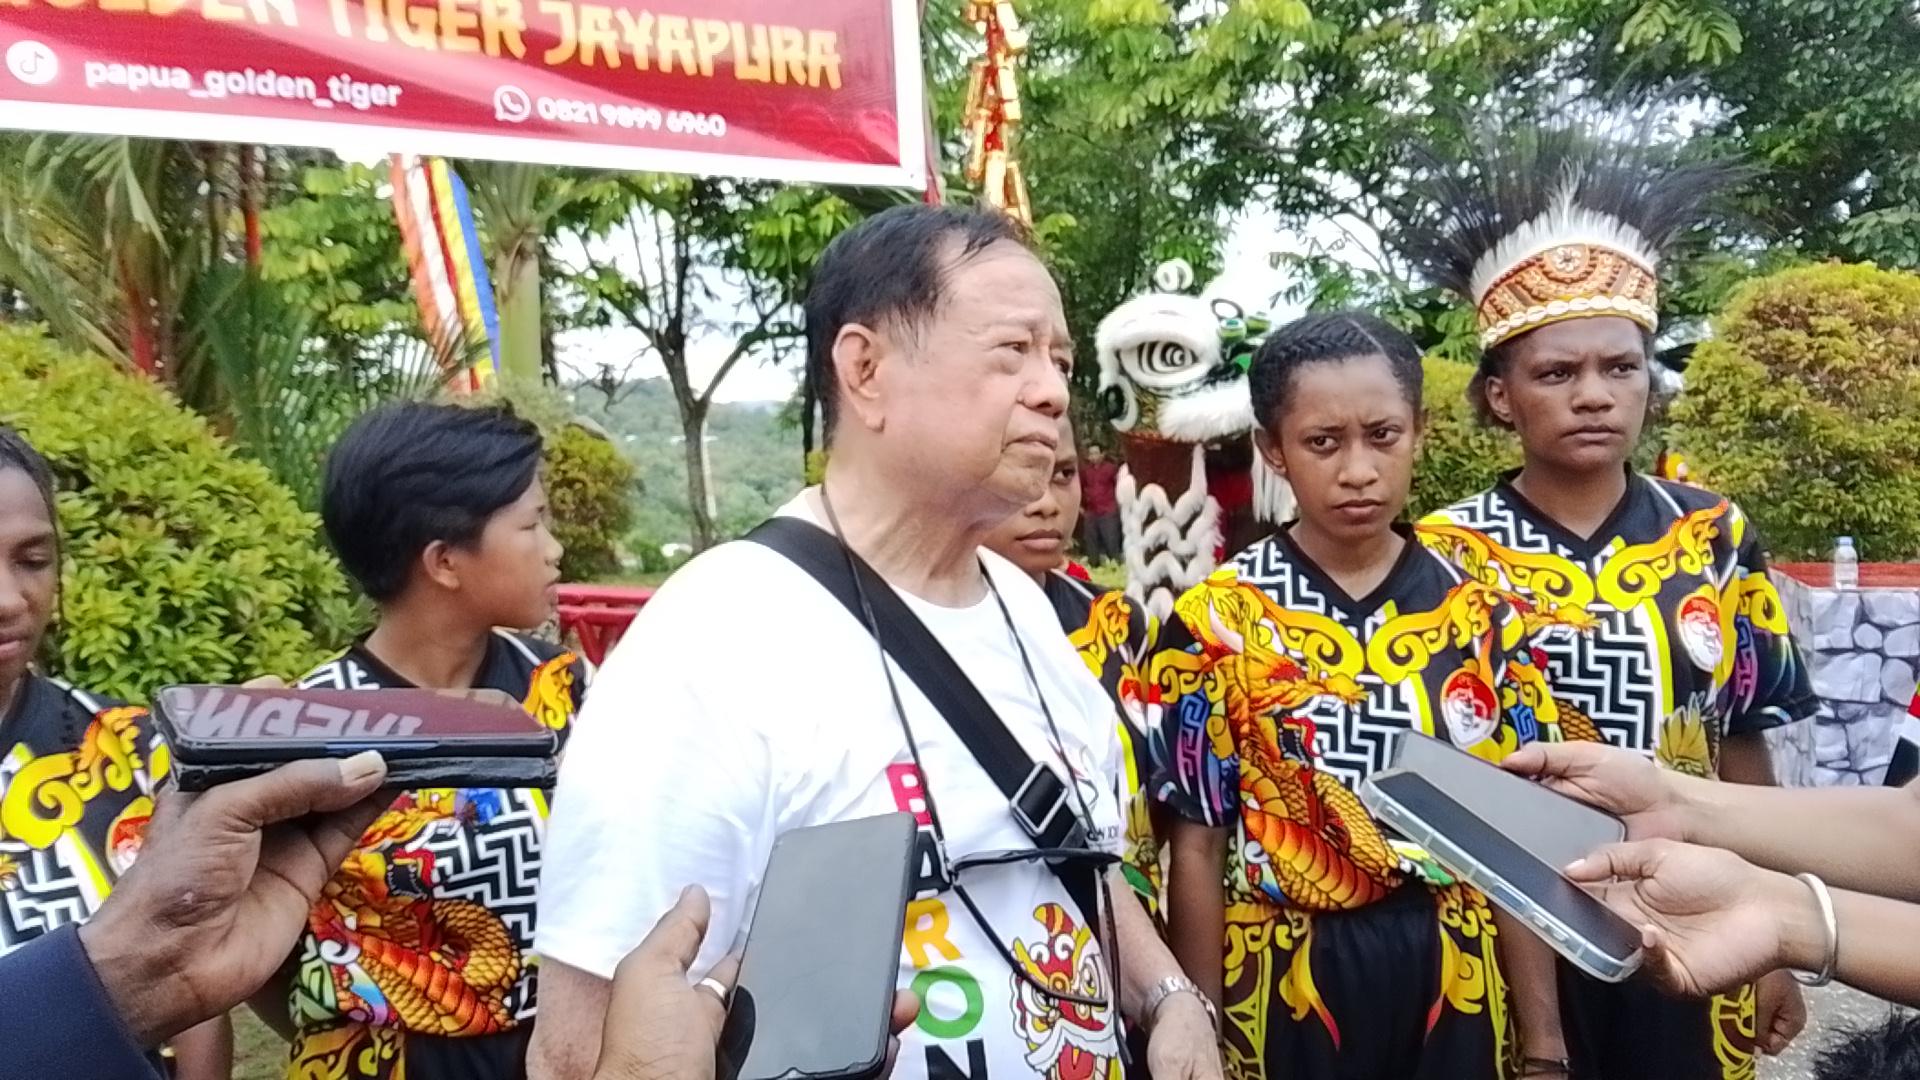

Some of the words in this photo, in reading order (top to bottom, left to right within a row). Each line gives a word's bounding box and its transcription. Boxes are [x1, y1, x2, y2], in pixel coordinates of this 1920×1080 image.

[538, 2, 842, 90] JAYAPURA
[85, 61, 402, 109] papua_golden_tiger
[537, 97, 598, 124] 0821
